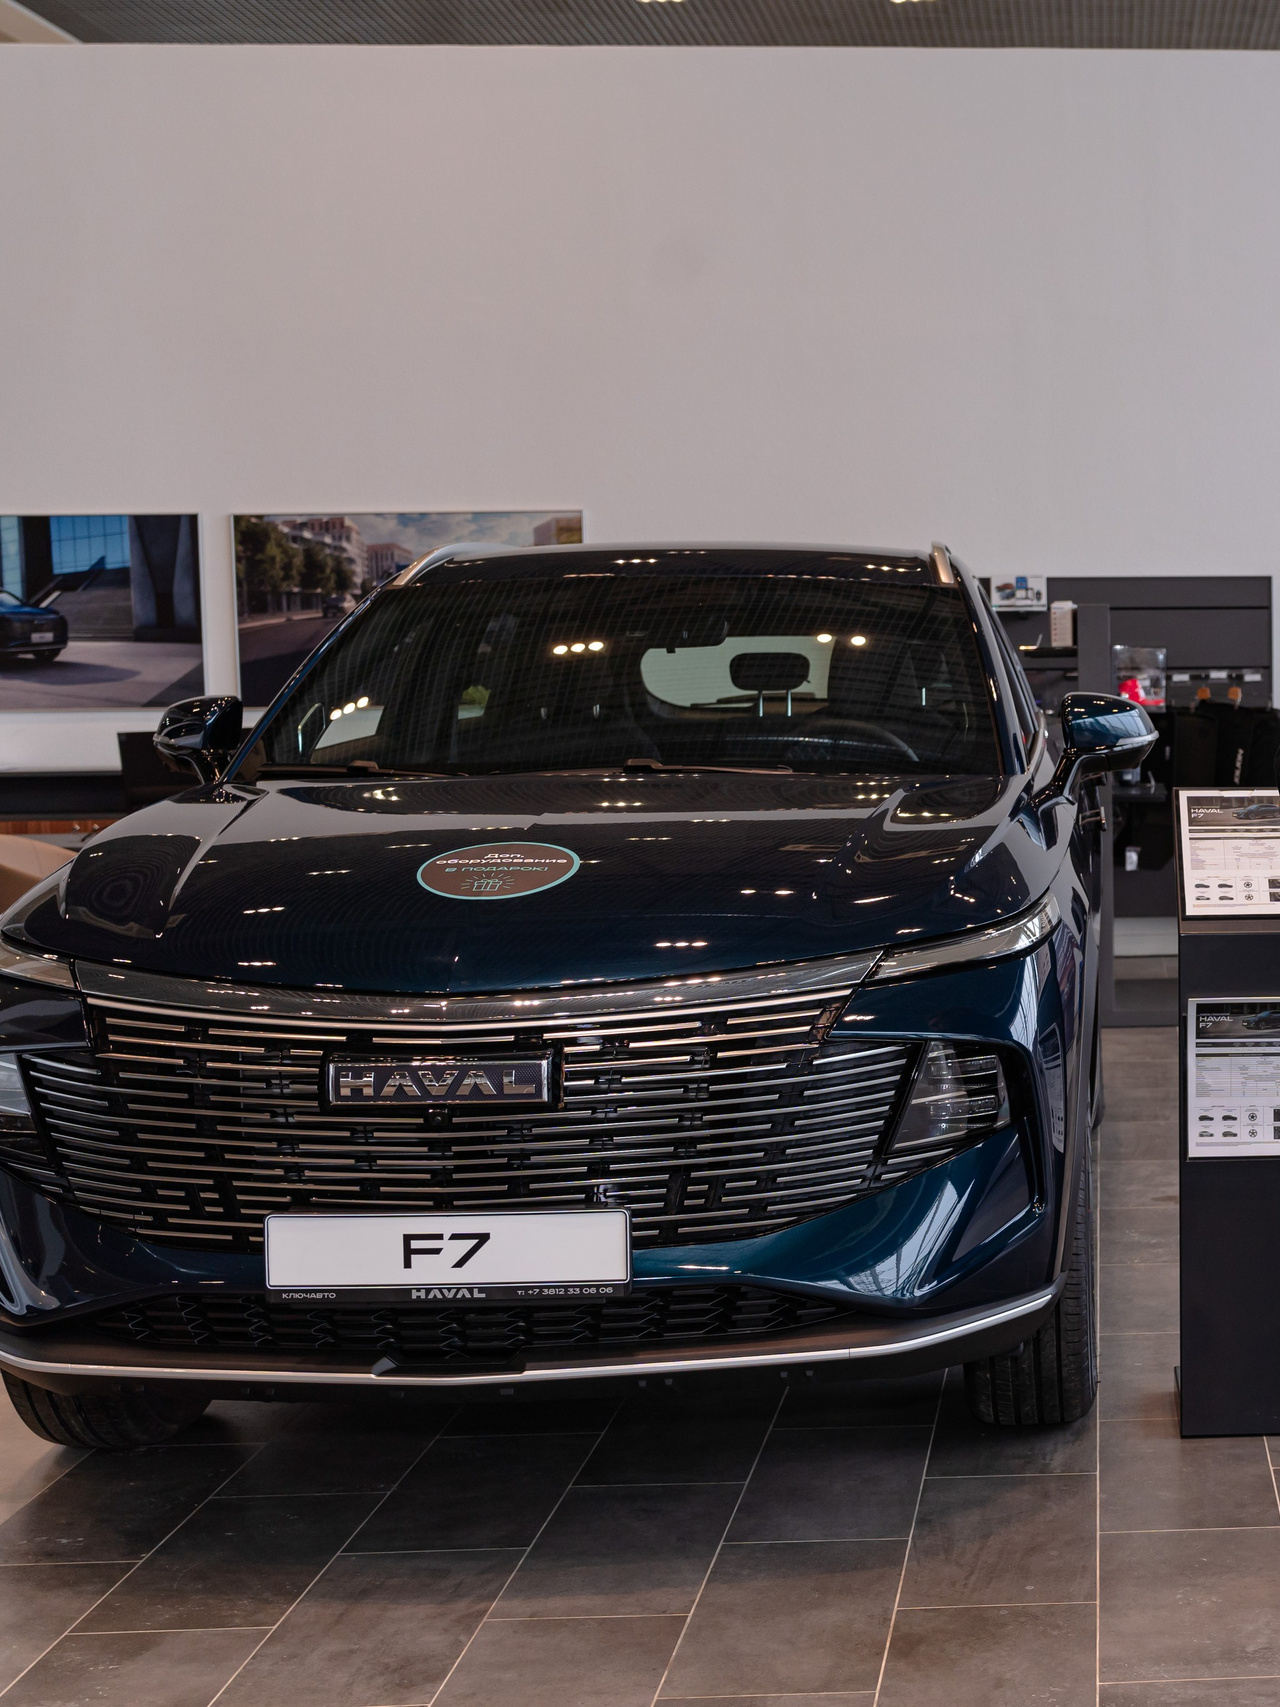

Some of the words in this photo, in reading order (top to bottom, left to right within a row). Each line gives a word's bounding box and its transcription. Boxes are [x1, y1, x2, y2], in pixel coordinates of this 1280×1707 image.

[340, 1070, 536, 1096] HAVAL
[402, 1232, 491, 1270] F7
[411, 1288, 486, 1299] HAVAL
